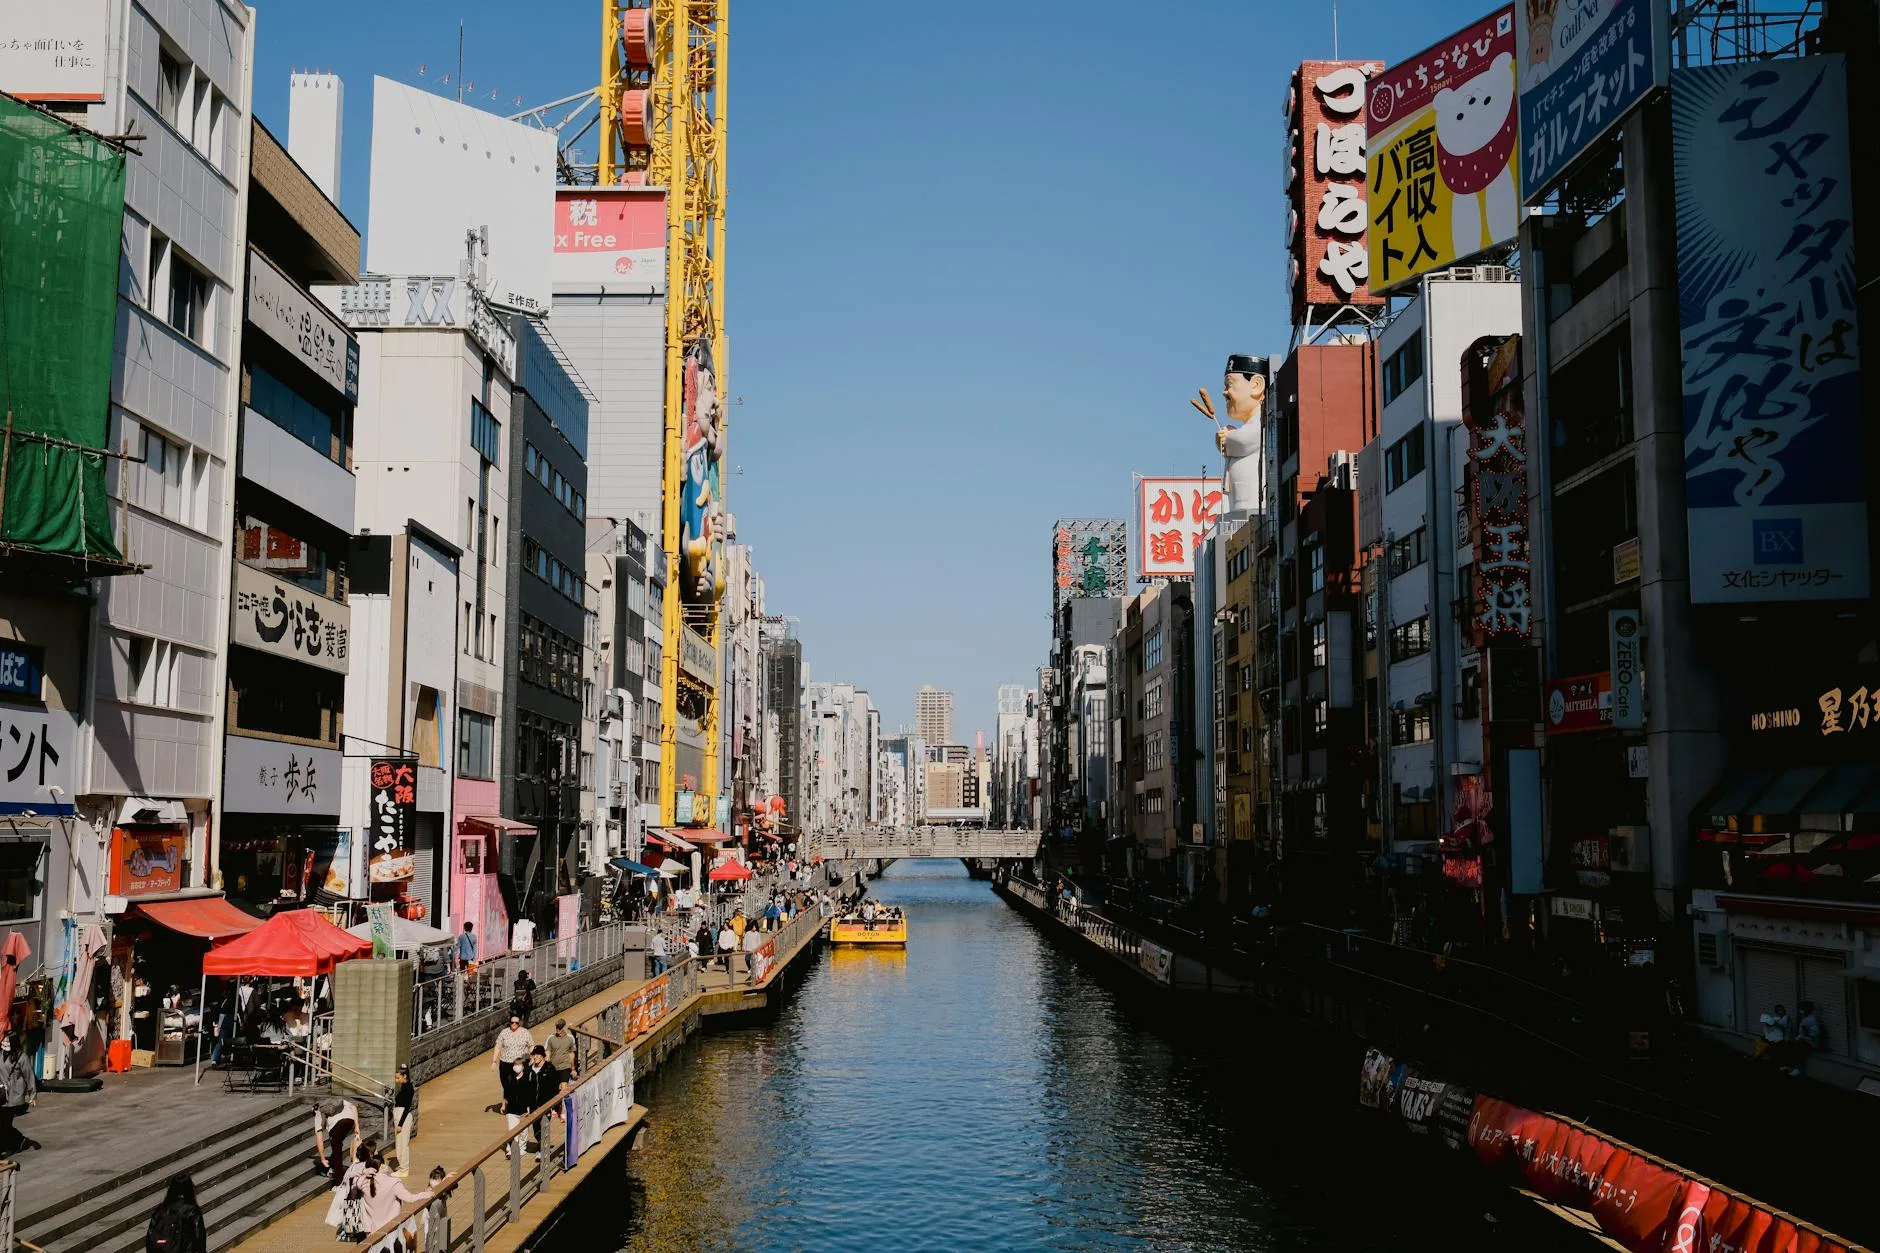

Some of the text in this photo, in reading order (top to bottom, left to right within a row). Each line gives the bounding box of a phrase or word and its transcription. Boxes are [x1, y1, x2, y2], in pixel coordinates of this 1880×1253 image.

[1395, 28, 1494, 99] いちごなび
[1430, 75, 1453, 94] 15navi
[1531, 5, 1636, 124] ITでチェーン店を改革する
[1528, 36, 1645, 184] ガルフネット
[1373, 134, 1405, 282] バイト
[1404, 125, 1438, 271] 高収入
[575, 231, 617, 248] Free
[1081, 537, 1108, 592] 千房
[1759, 530, 1797, 553] BX
[255, 585, 323, 656] うなぎ
[1565, 698, 1598, 713] MITHILA
[1617, 641, 1632, 719] ZERO cafe
[1751, 708, 1801, 731] HOSHINO
[284, 753, 318, 804] 歩兵
[395, 763, 416, 804] 大阪
